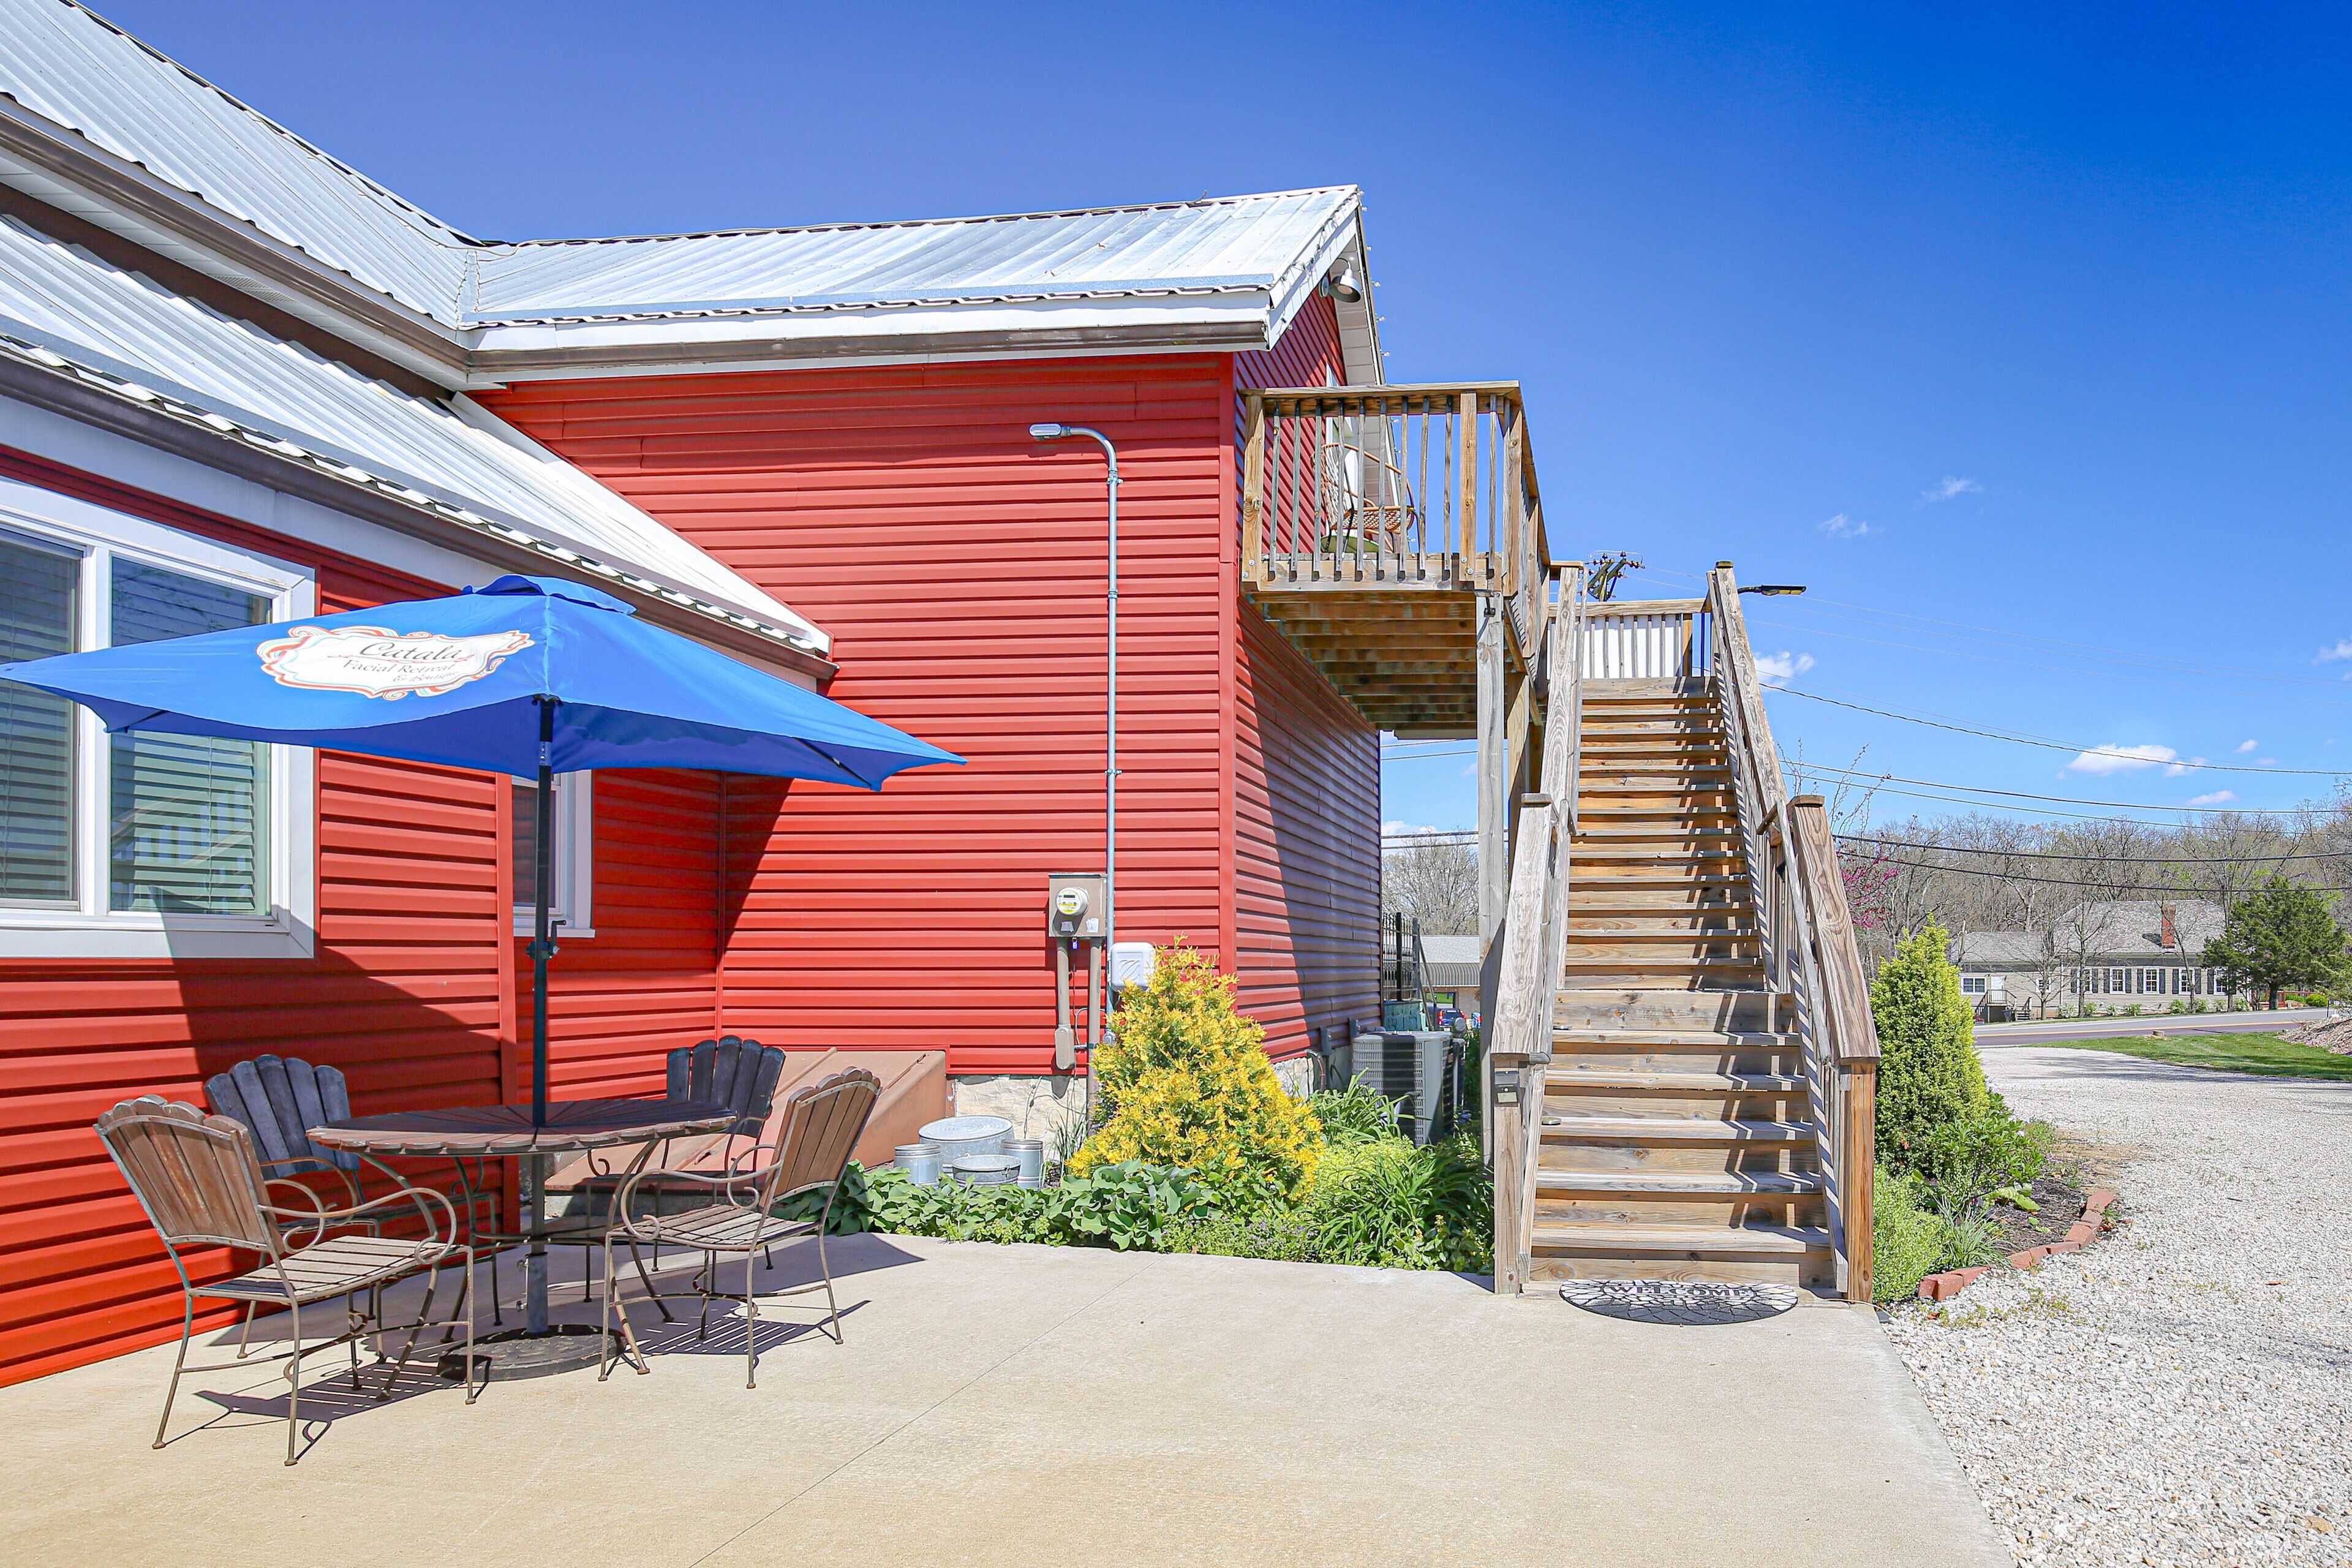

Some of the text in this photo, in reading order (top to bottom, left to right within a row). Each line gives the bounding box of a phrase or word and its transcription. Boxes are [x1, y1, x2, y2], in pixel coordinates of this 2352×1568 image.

[359, 642, 462, 660] Catala
[343, 660, 456, 674] Facial Retreat
[1608, 1286, 1753, 1297] WELCOME
